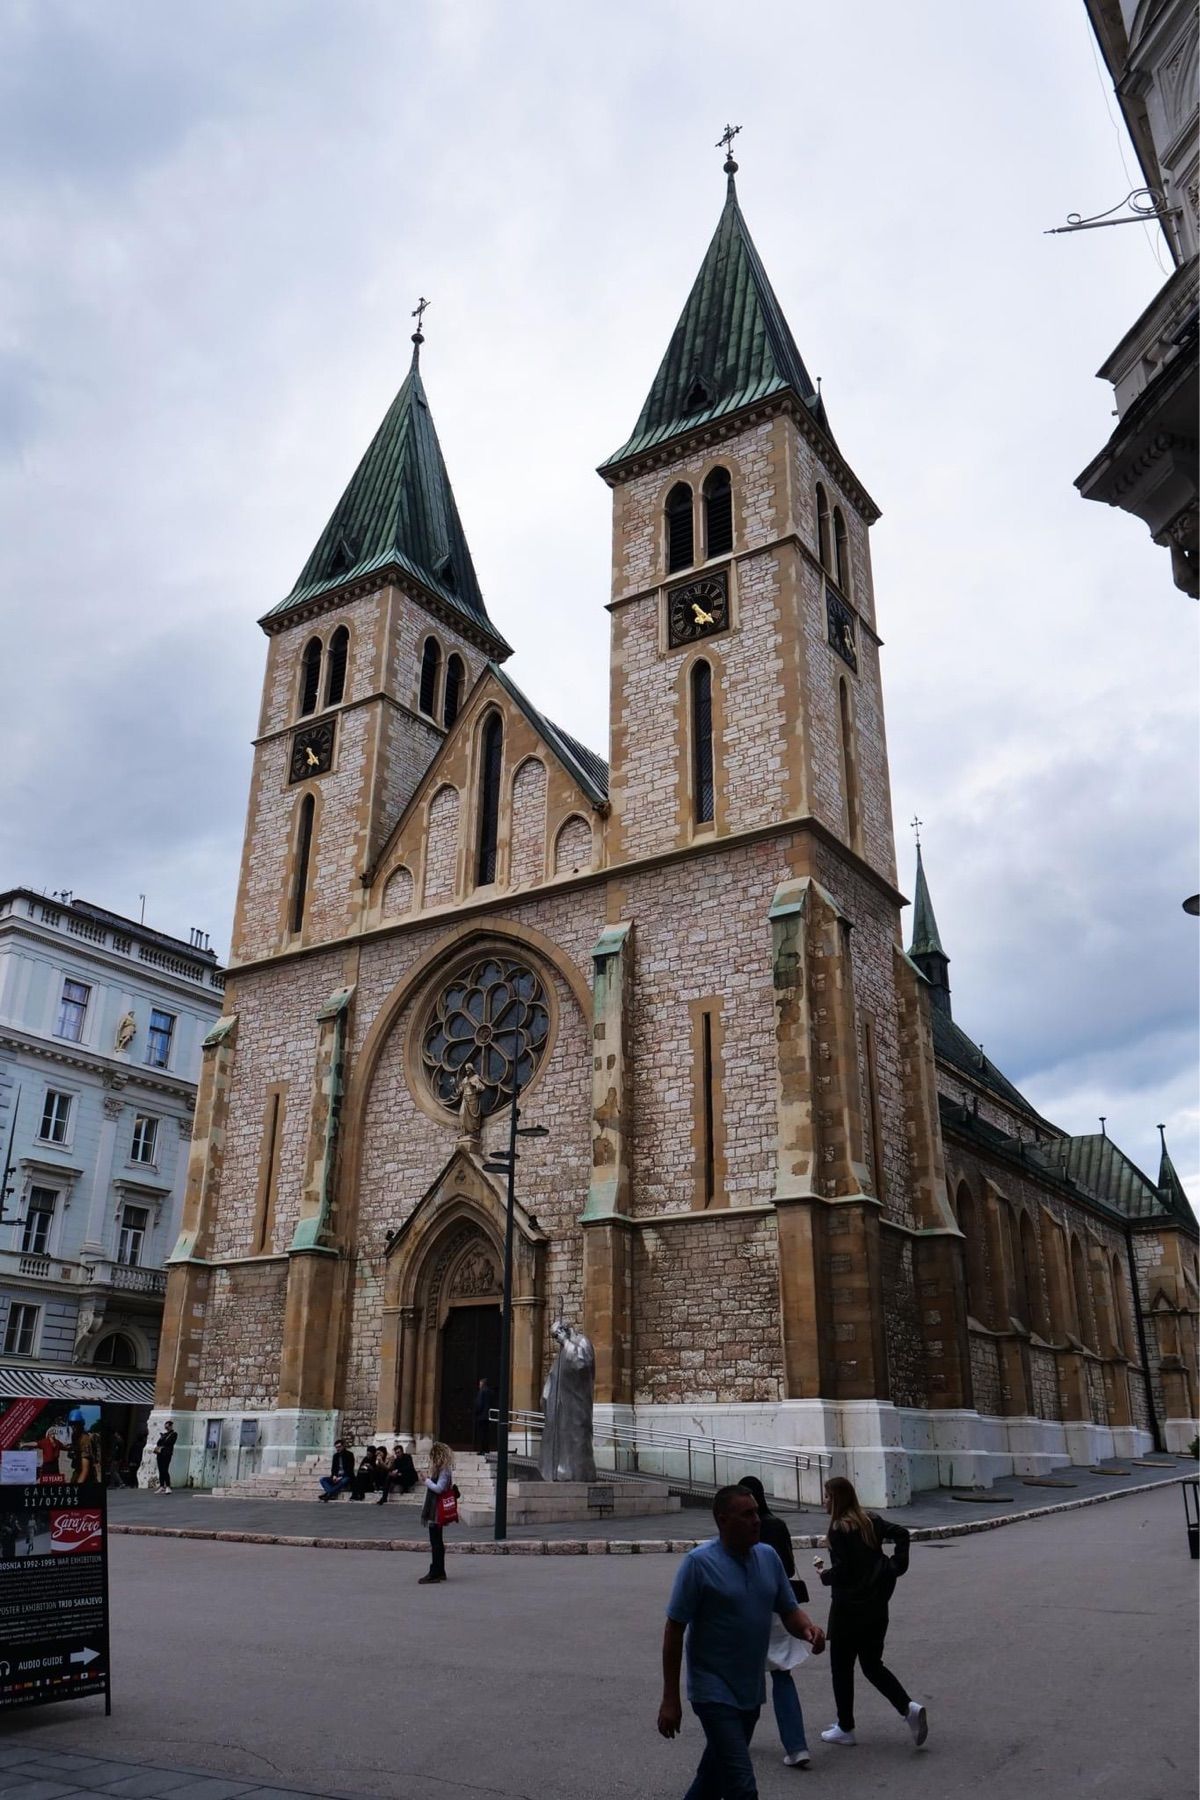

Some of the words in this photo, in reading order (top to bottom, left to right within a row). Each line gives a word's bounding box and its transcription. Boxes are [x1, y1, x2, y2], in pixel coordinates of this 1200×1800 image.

[24, 1487, 79, 1496] GALLERY
[24, 1497, 79, 1507] 11/07/95
[52, 1514, 100, 1538] Sarajevo
[23, 1559, 56, 1568] 1992-1995
[70, 1555, 102, 1564] EXHIBITION
[22, 1602, 57, 1613] EXHIBITION
[58, 1600, 72, 1608] TRIO
[74, 1597, 103, 1607] SARAJEVO
[18, 1660, 41, 1671] AUDIO
[42, 1656, 63, 1665] GUIDE
